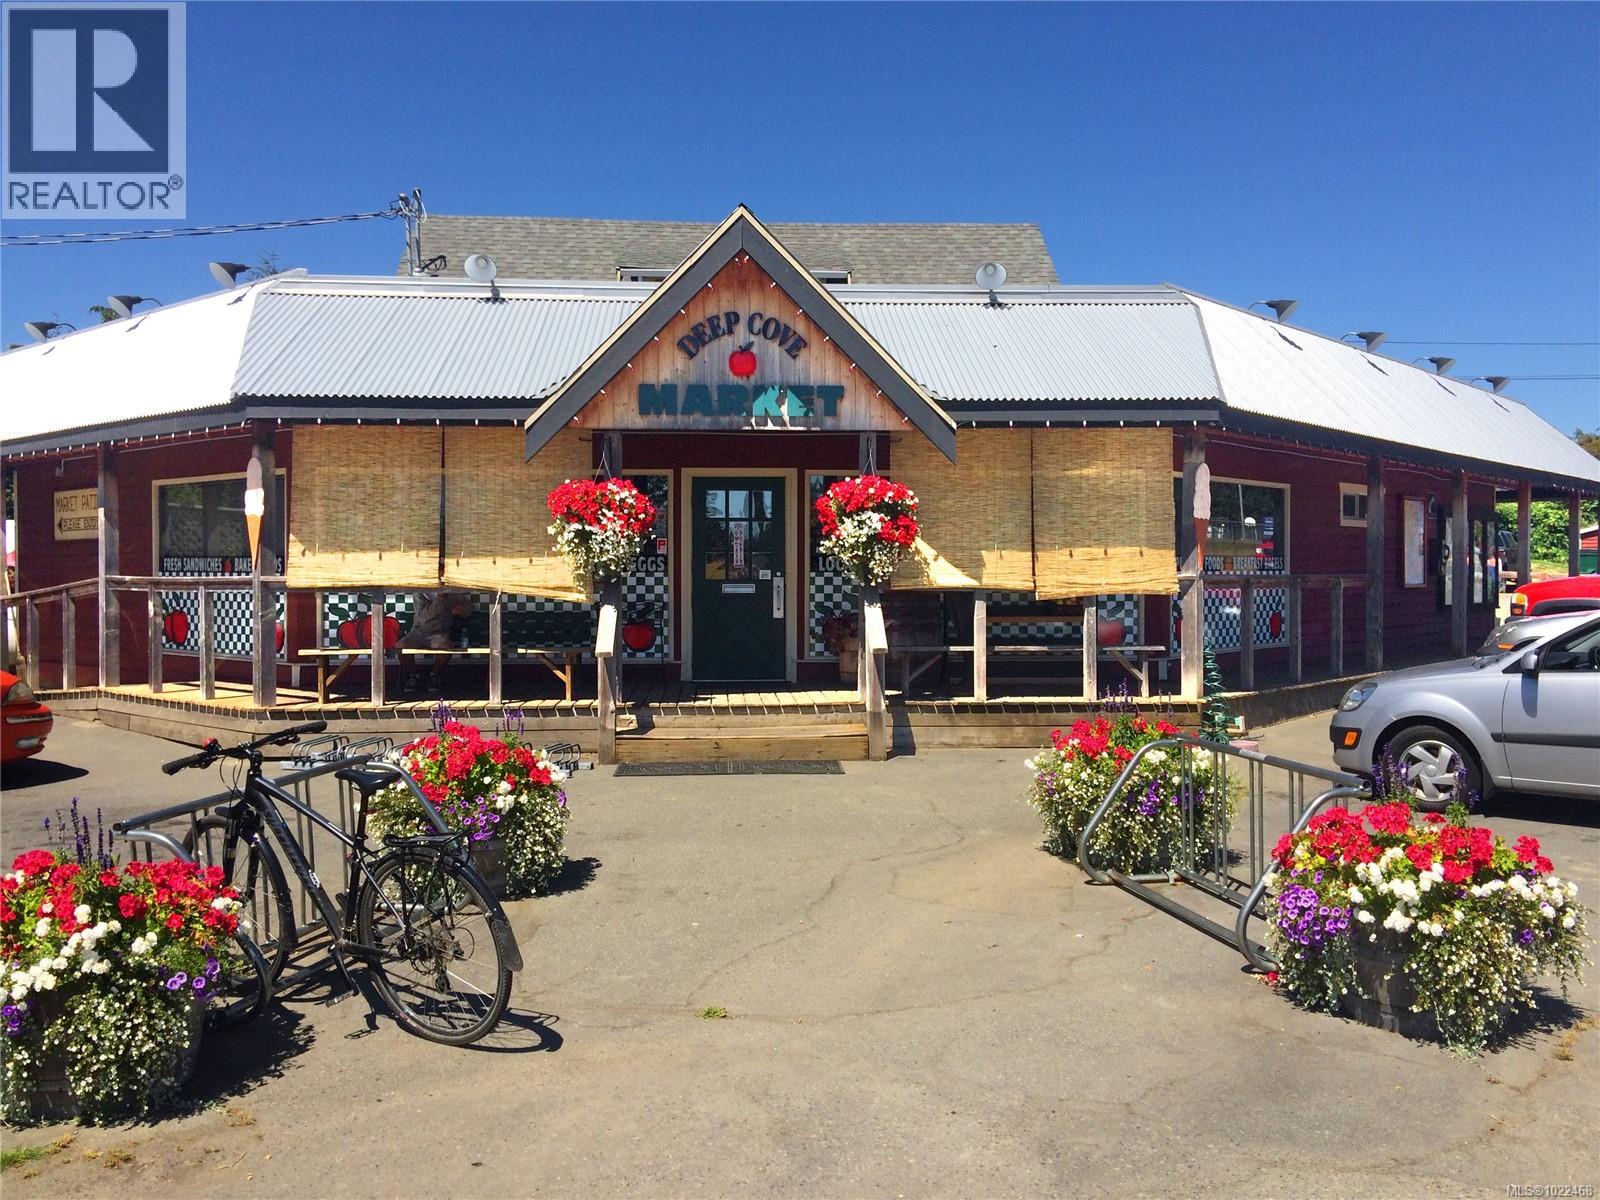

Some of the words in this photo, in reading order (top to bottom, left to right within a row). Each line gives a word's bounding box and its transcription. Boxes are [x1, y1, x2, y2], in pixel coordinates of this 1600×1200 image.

[676, 311, 740, 360] DEEP
[747, 312, 808, 360] COVE
[638, 383, 845, 417] MARKET
[55, 495, 78, 513] MARKET
[81, 493, 98, 511] PATI
[63, 519, 81, 530] PLEASE
[83, 518, 98, 529] ENJO
[163, 557, 181, 571] FRESH
[183, 557, 222, 571] SANDWICHES
[234, 557, 252, 571] BAKE
[629, 556, 665, 572] EGGS
[1204, 556, 1225, 571] FOODS
[1232, 556, 1263, 571] BREAKFAST
